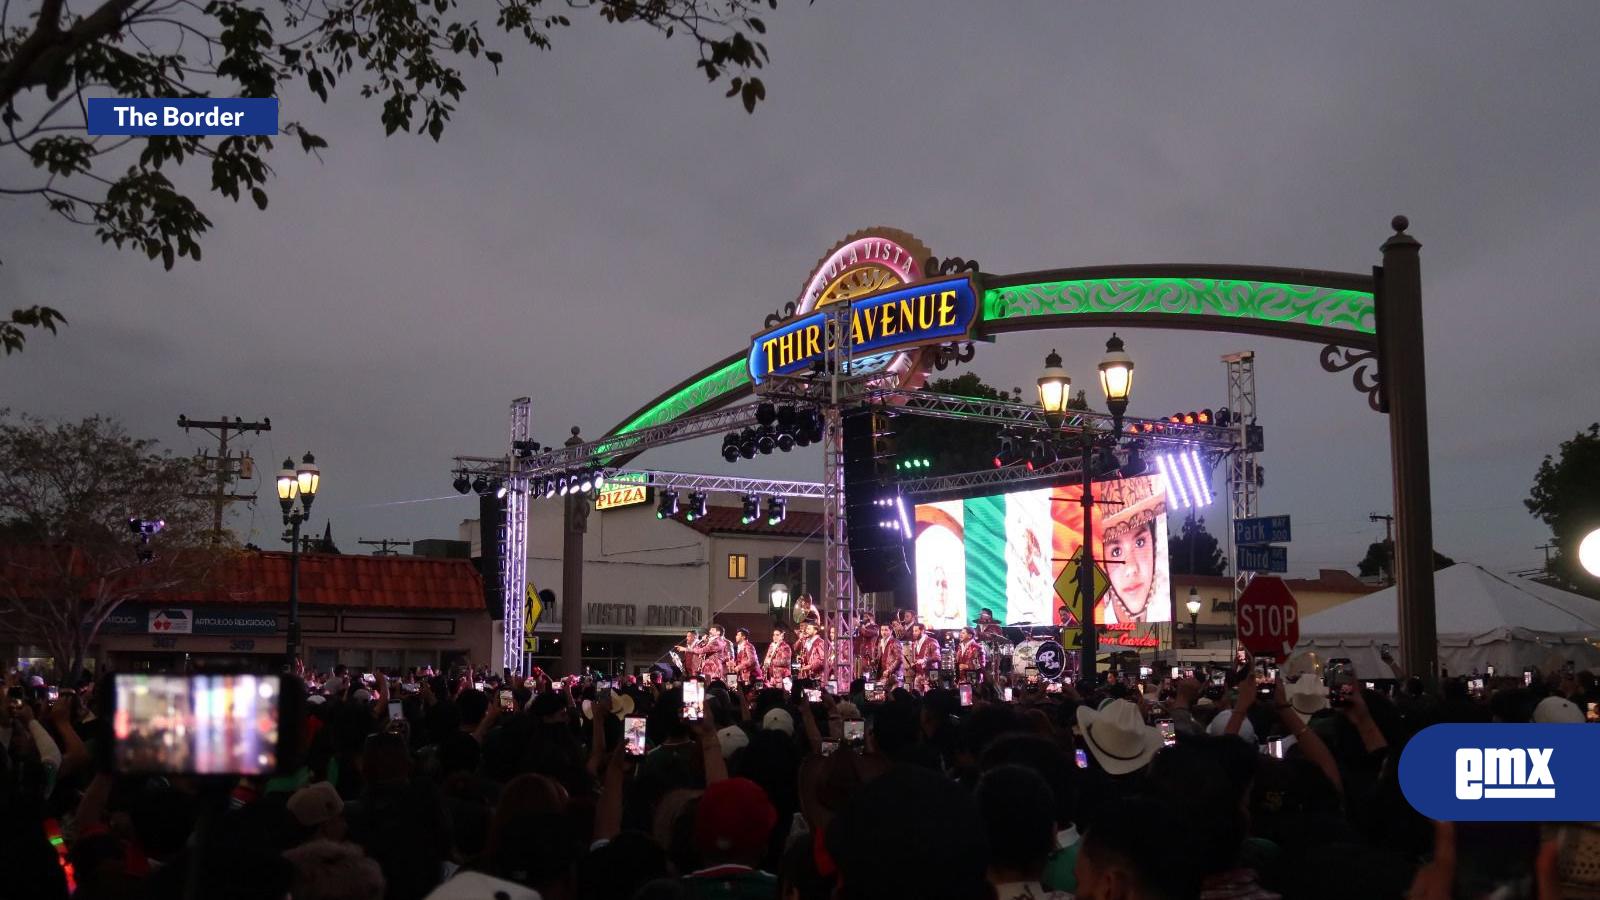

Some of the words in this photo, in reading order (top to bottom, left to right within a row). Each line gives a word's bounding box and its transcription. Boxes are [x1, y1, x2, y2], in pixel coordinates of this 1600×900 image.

[863, 241, 914, 276] VISTA
[851, 290, 956, 345] AVENUE
[597, 487, 645, 507] PIZZA
[1236, 520, 1265, 541] Park
[1239, 547, 1270, 569] Third
[587, 602, 636, 626] VISTA
[647, 604, 703, 627] PHOTO
[1240, 604, 1296, 637] STOP
